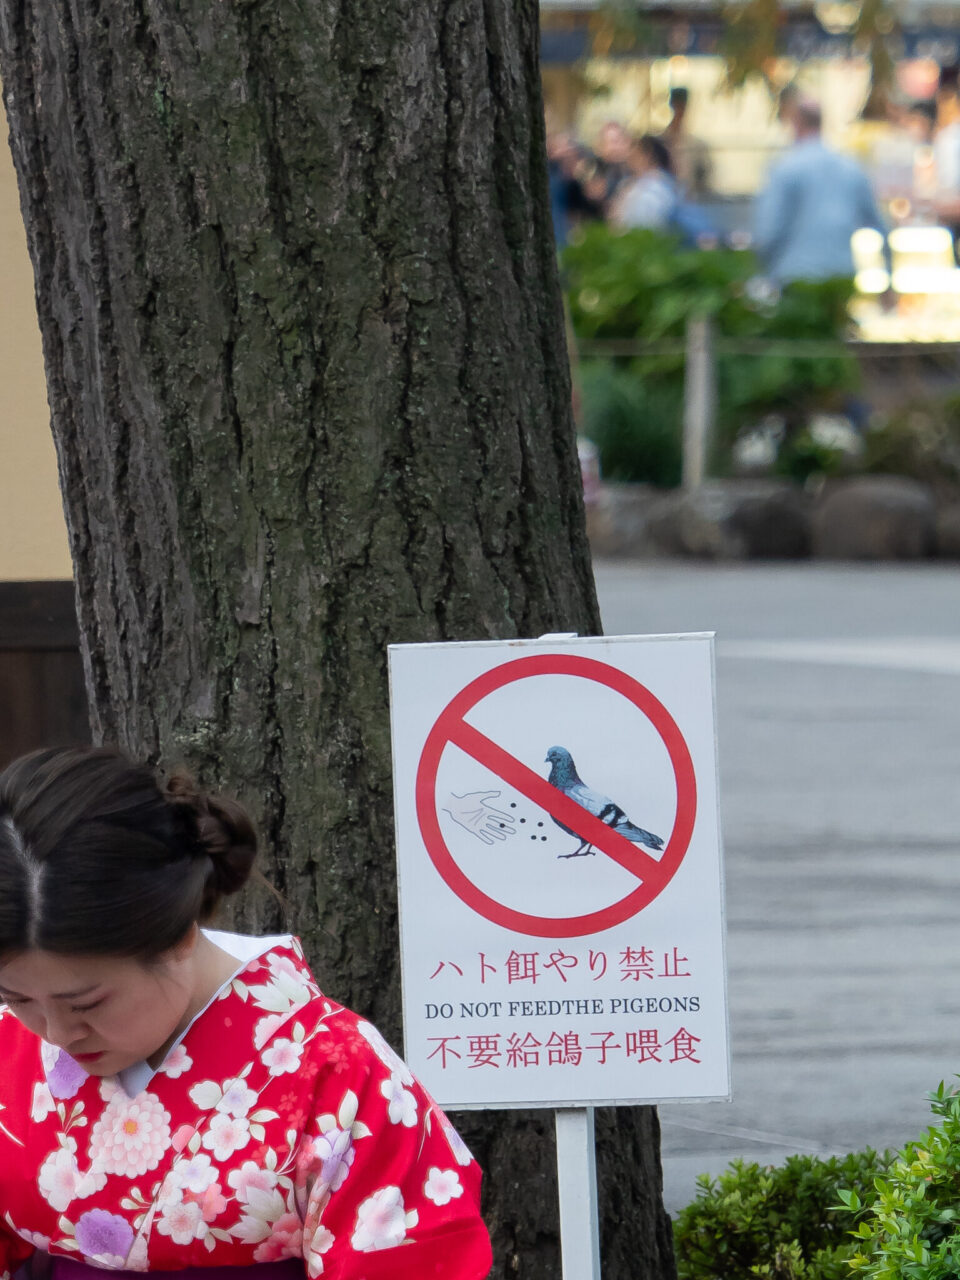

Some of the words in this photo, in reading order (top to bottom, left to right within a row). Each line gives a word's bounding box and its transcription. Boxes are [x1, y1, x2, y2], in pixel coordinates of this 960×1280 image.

[429, 946, 692, 984] ハト餌やり禁止
[425, 1003, 454, 1019] DO
[460, 1001, 502, 1018] NOT
[609, 996, 701, 1014] PIGEONS
[426, 1026, 702, 1069] 不要給鴿子喂食
